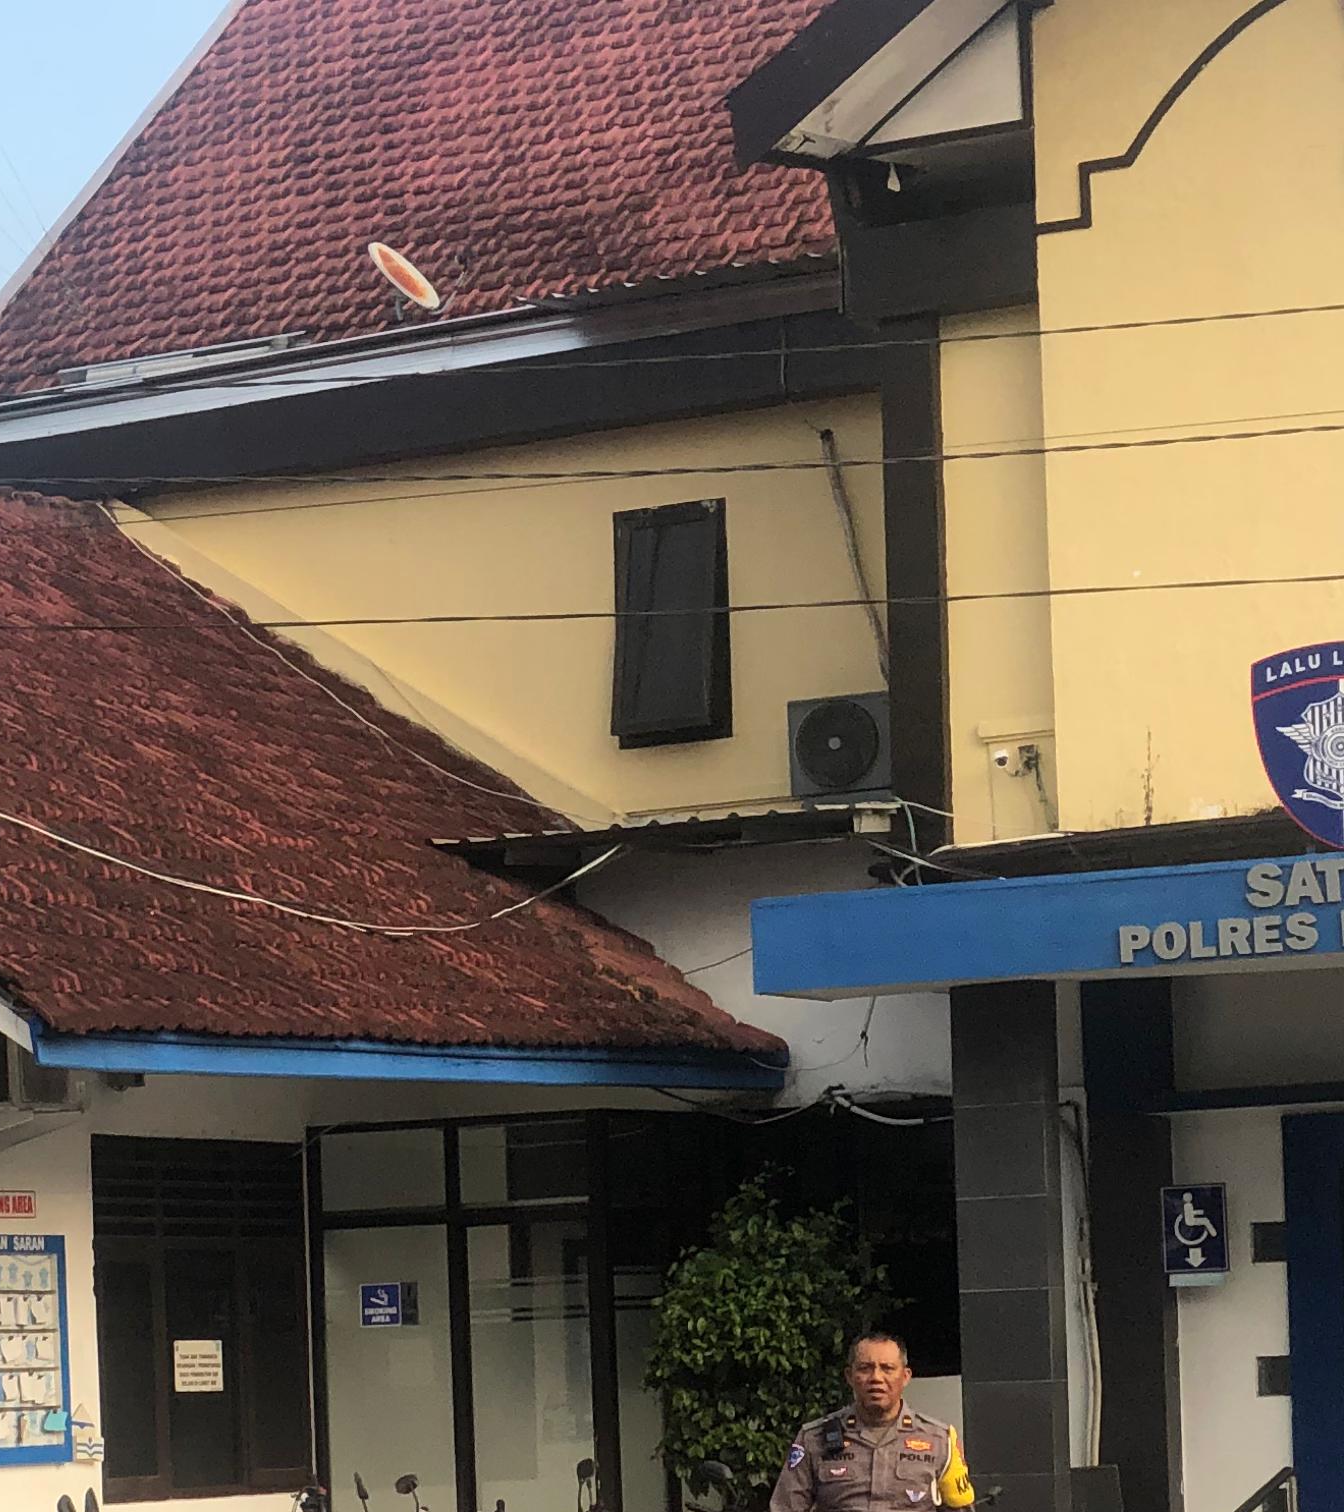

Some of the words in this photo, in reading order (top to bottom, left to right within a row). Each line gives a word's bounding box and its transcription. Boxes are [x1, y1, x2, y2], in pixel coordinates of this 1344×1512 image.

[1266, 653, 1321, 682] LALU
[1119, 913, 1320, 964] POLRES
[12, 1195, 33, 1213] AREA
[13, 1236, 45, 1251] SARAN
[900, 1453, 935, 1463] POLRI
